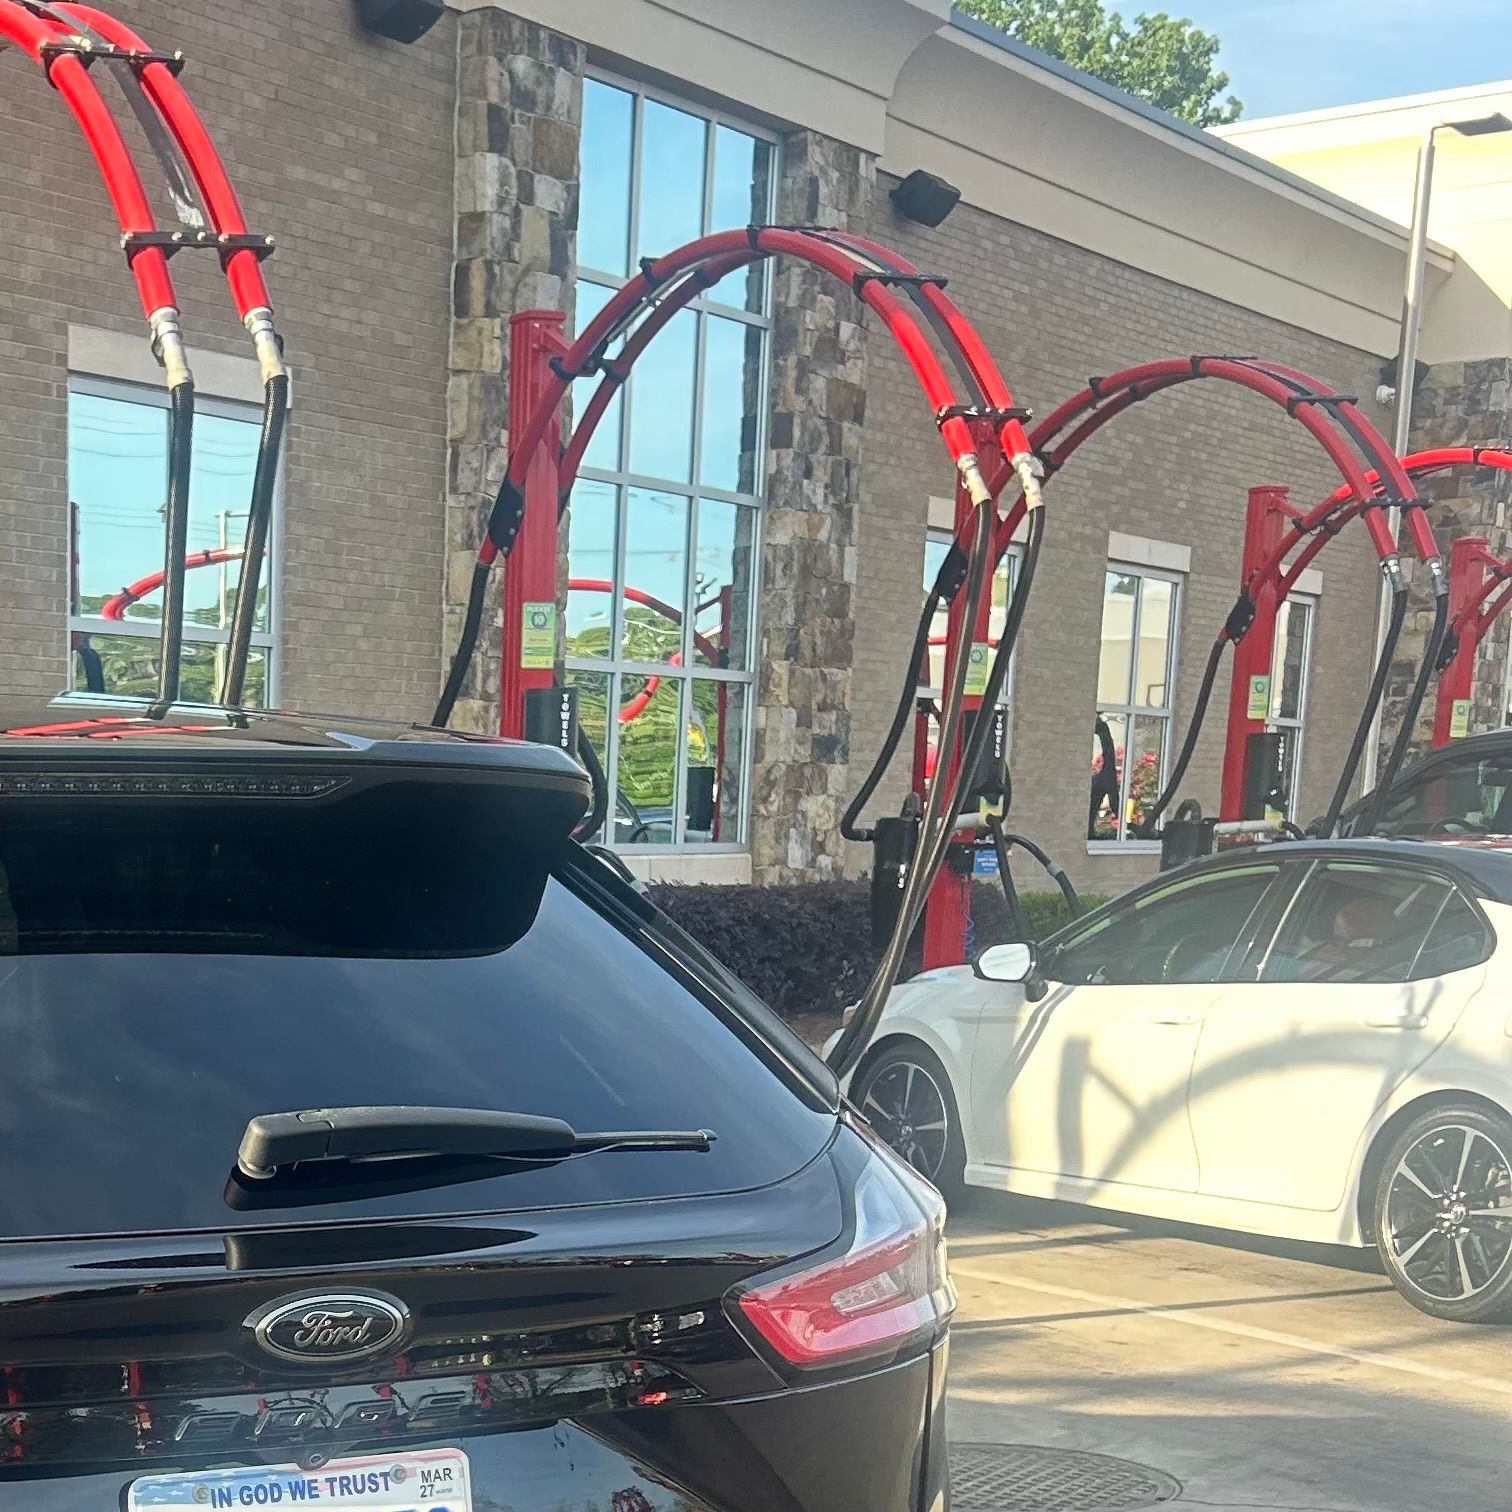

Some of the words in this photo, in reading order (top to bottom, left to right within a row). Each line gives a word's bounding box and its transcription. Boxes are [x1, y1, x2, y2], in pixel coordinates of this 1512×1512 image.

[560, 693, 570, 747] TOWELS
[293, 1310, 374, 1348] Ford
[210, 1487, 233, 1509] IN
[239, 1482, 284, 1506] GOD
[288, 1478, 320, 1501] WE
[325, 1471, 390, 1497] TRUST
[419, 1483, 435, 1498] 27
[420, 1467, 454, 1483] MAR
